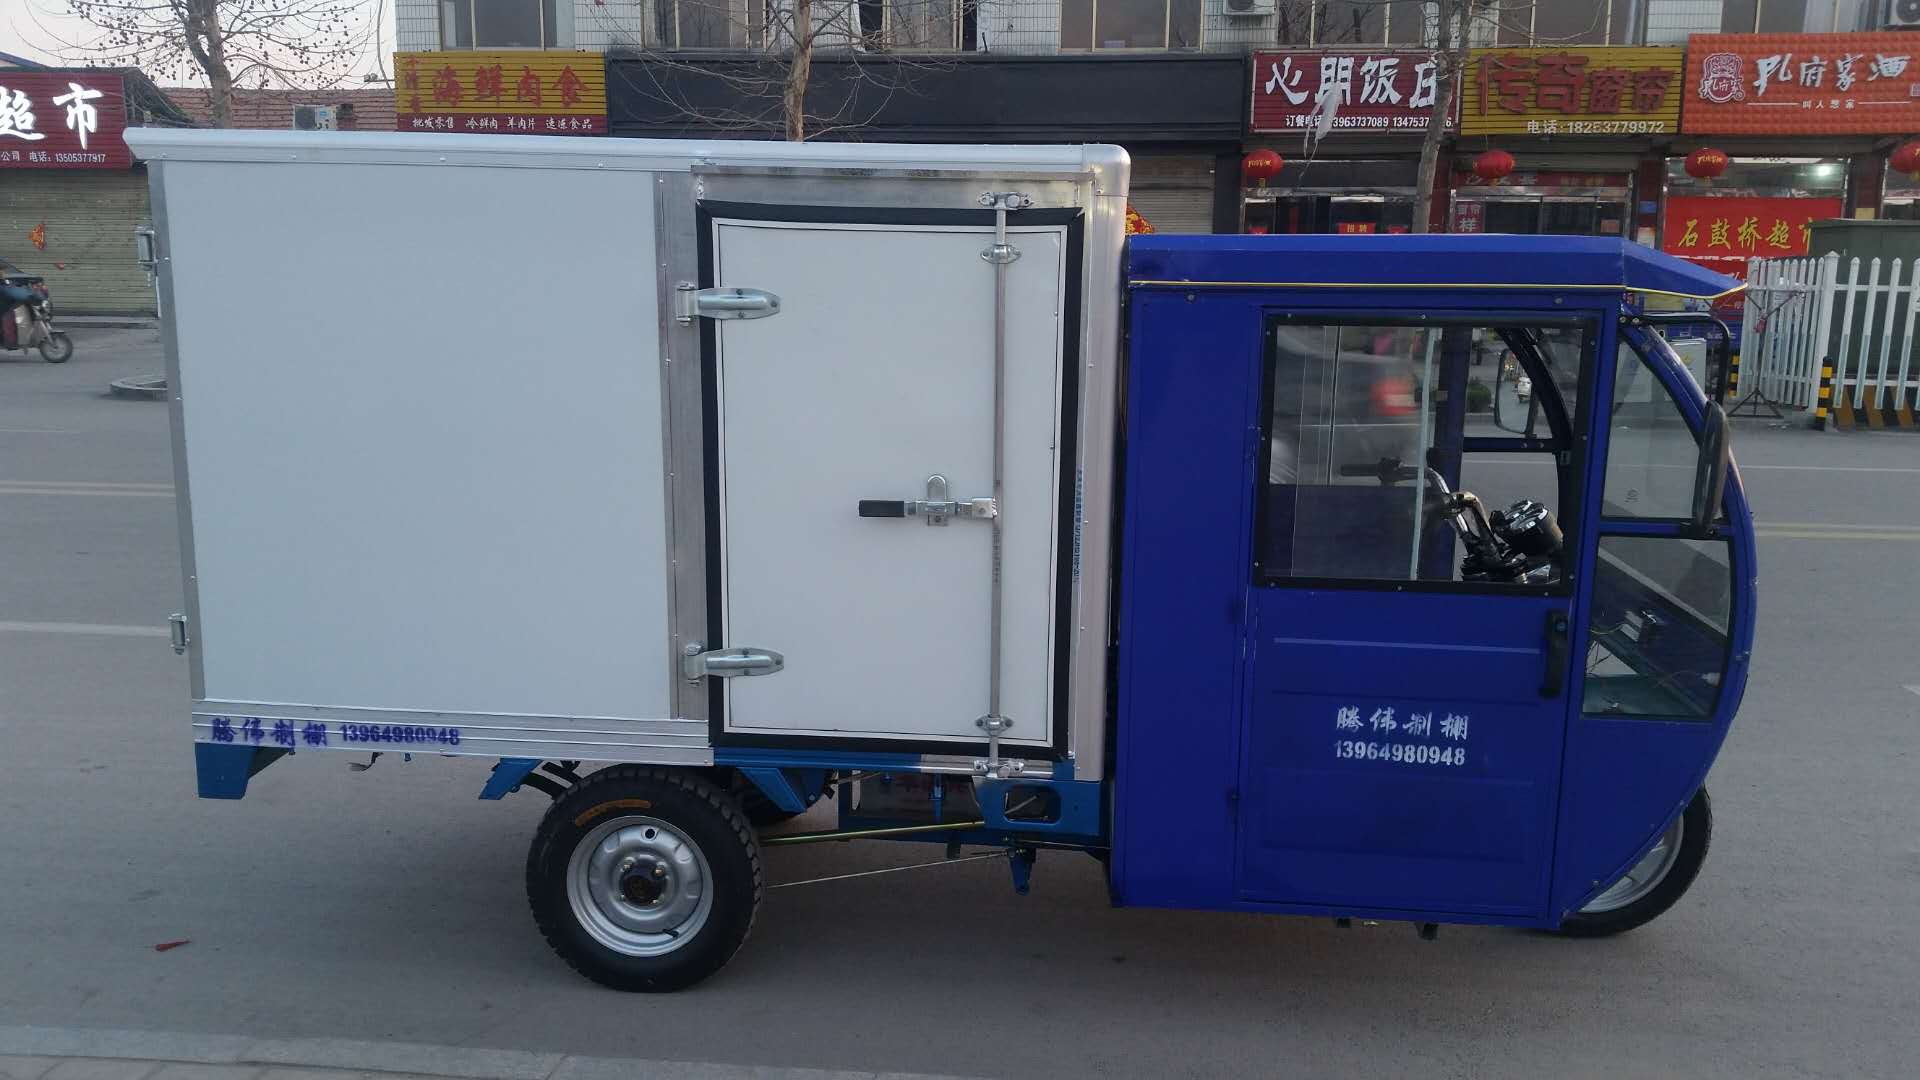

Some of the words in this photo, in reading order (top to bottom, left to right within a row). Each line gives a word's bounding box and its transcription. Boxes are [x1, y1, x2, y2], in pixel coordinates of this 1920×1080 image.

[432, 63, 592, 108] 海鲜肉食
[1475, 52, 1675, 115] 传奇窗帘
[1752, 53, 1911, 97] 孔府家酒
[412, 116, 455, 129] 批发零售
[465, 117, 498, 129] 冷鲜肉
[507, 117, 536, 130] 羊肉片
[546, 117, 593, 130] 速冻食品
[1328, 117, 1389, 127] 3963737089
[1393, 116, 1452, 127] 13475376
[1, 151, 20, 162] 公司
[339, 723, 461, 746] 13964980948
[1336, 704, 1469, 741] 腾伟制棚
[1334, 740, 1466, 766] 13964980948
